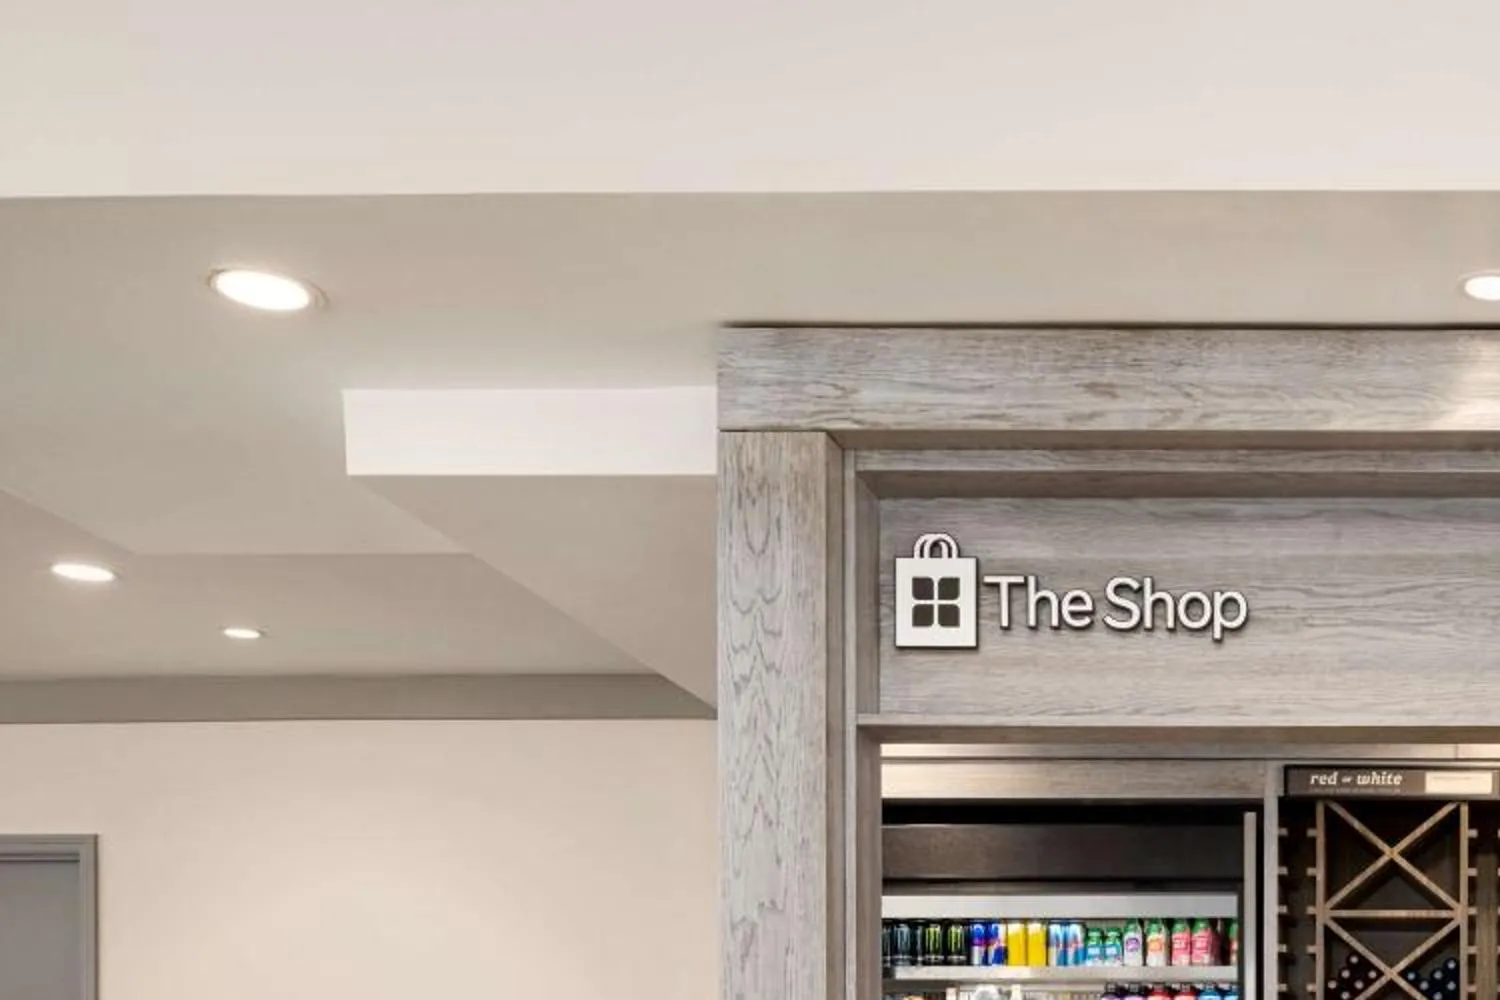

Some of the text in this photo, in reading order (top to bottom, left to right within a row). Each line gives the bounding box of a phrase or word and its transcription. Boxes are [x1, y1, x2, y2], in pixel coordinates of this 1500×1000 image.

[983, 575, 1248, 641] The Shop
[1310, 771, 1338, 785] red
[1357, 771, 1403, 785] white
